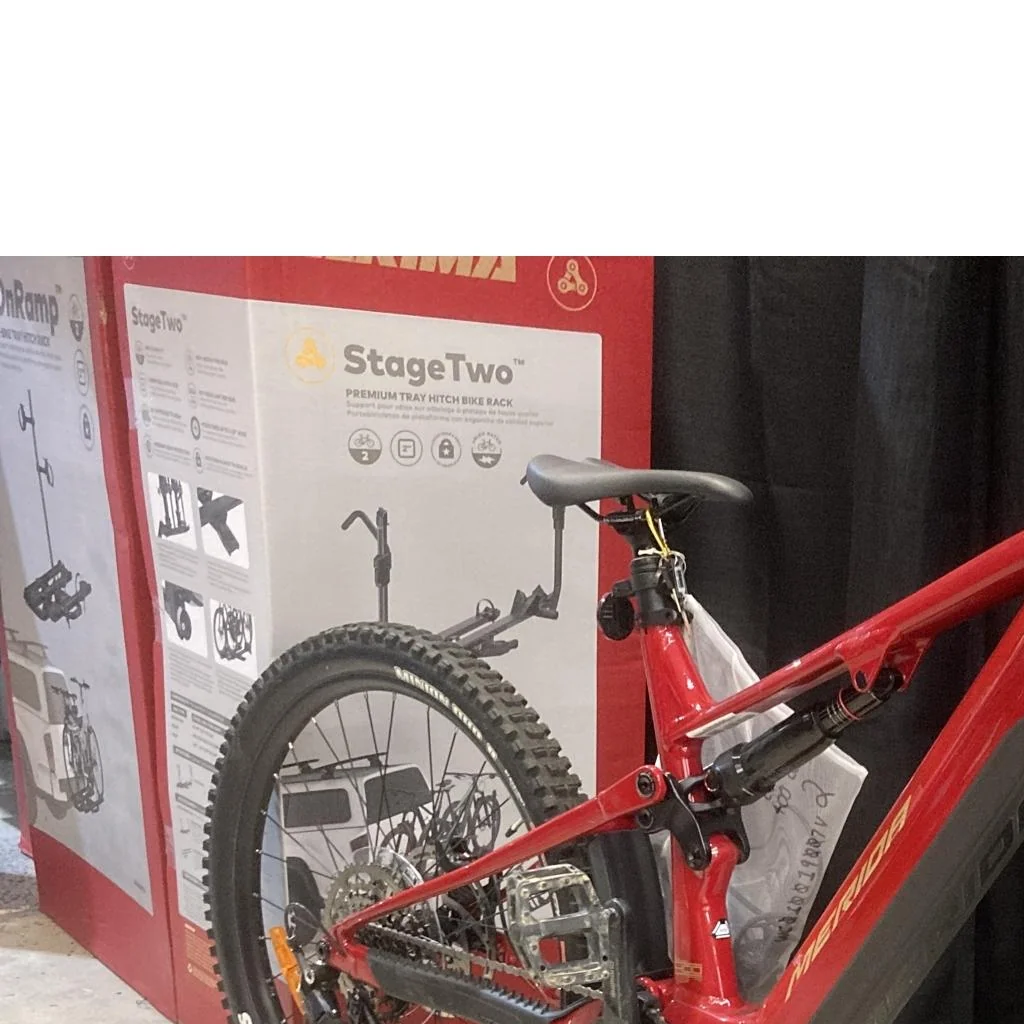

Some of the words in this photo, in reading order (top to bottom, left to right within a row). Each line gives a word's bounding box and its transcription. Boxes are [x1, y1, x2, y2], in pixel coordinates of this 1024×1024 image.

[131, 306, 184, 333] StageTwo
[343, 344, 514, 387] StageTwo
[345, 388, 398, 400] PREMIUM
[399, 391, 427, 403] TRAY
[428, 393, 460, 405] HITCH
[461, 396, 484, 406] BIKE
[486, 397, 514, 408] RACK
[361, 451, 369, 461] 2
[784, 795, 912, 1003] MERIDA
